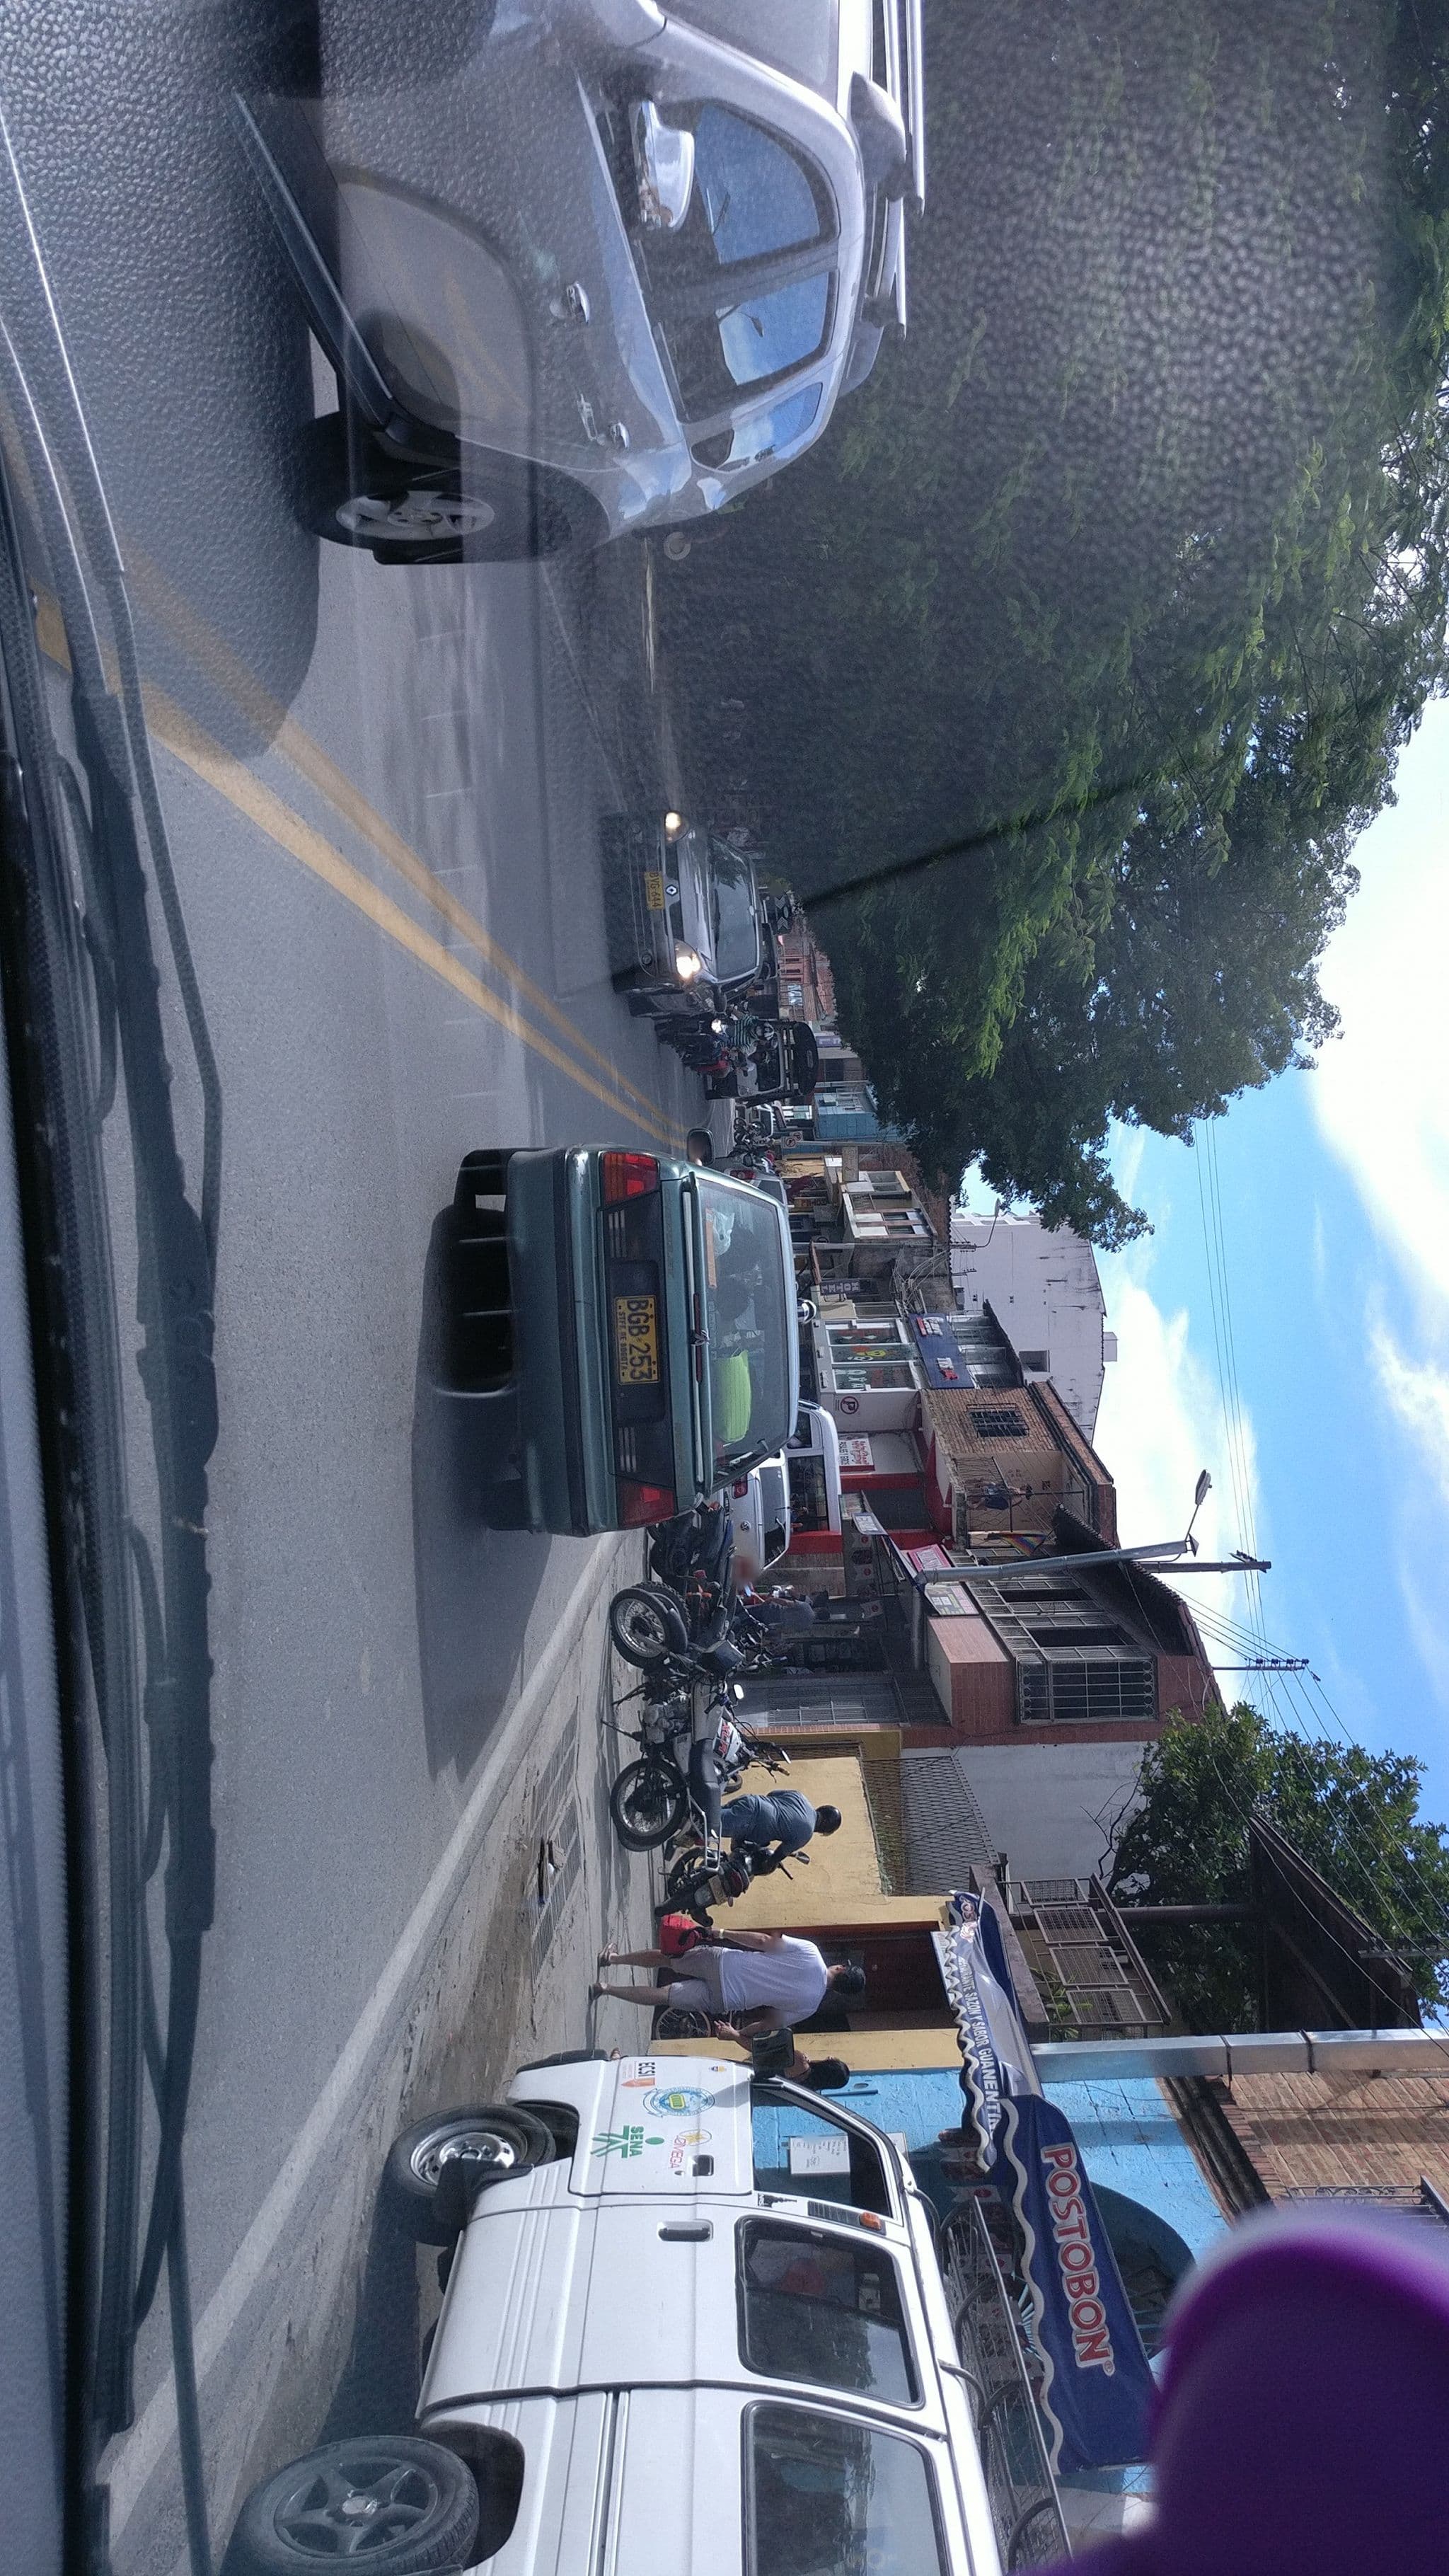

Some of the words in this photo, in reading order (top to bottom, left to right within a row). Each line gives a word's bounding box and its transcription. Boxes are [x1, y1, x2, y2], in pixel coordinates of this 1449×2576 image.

[821, 1282, 859, 1293] HOTEL
[627, 1299, 650, 1337] BGB
[629, 1342, 652, 1380] 253
[964, 1992, 981, 2014] SAZON
[971, 2022, 990, 2047] SABOR
[638, 2062, 656, 2077] ECSI
[629, 2126, 645, 2157] SENA
[1043, 2146, 1112, 2363] POSTOBON
